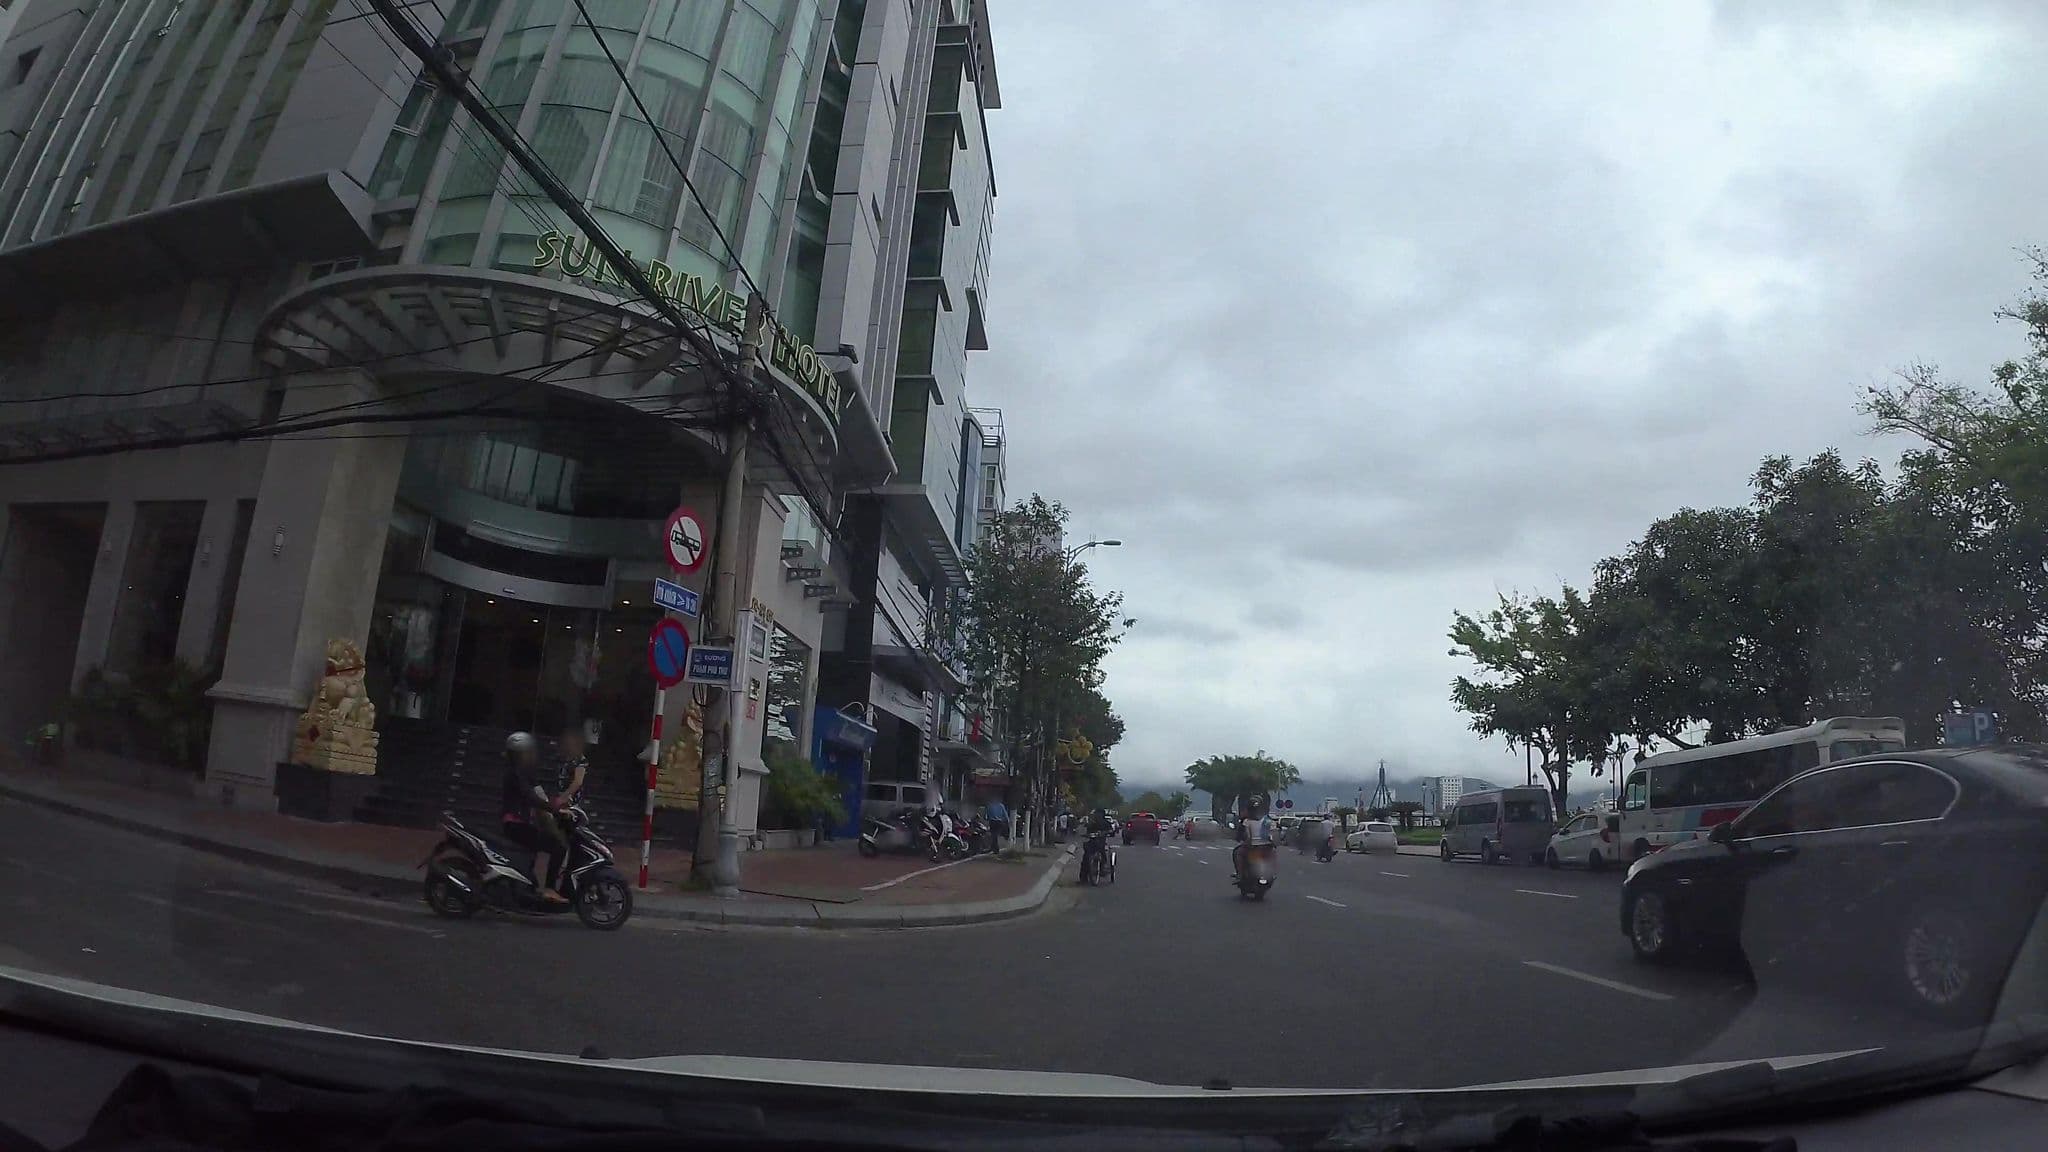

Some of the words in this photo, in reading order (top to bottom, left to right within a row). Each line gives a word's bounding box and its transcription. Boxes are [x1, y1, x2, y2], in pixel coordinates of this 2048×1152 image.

[533, 230, 632, 287] SUN
[647, 258, 766, 348] RIVE
[776, 324, 841, 425] HOTEL
[1974, 712, 1988, 741] P
